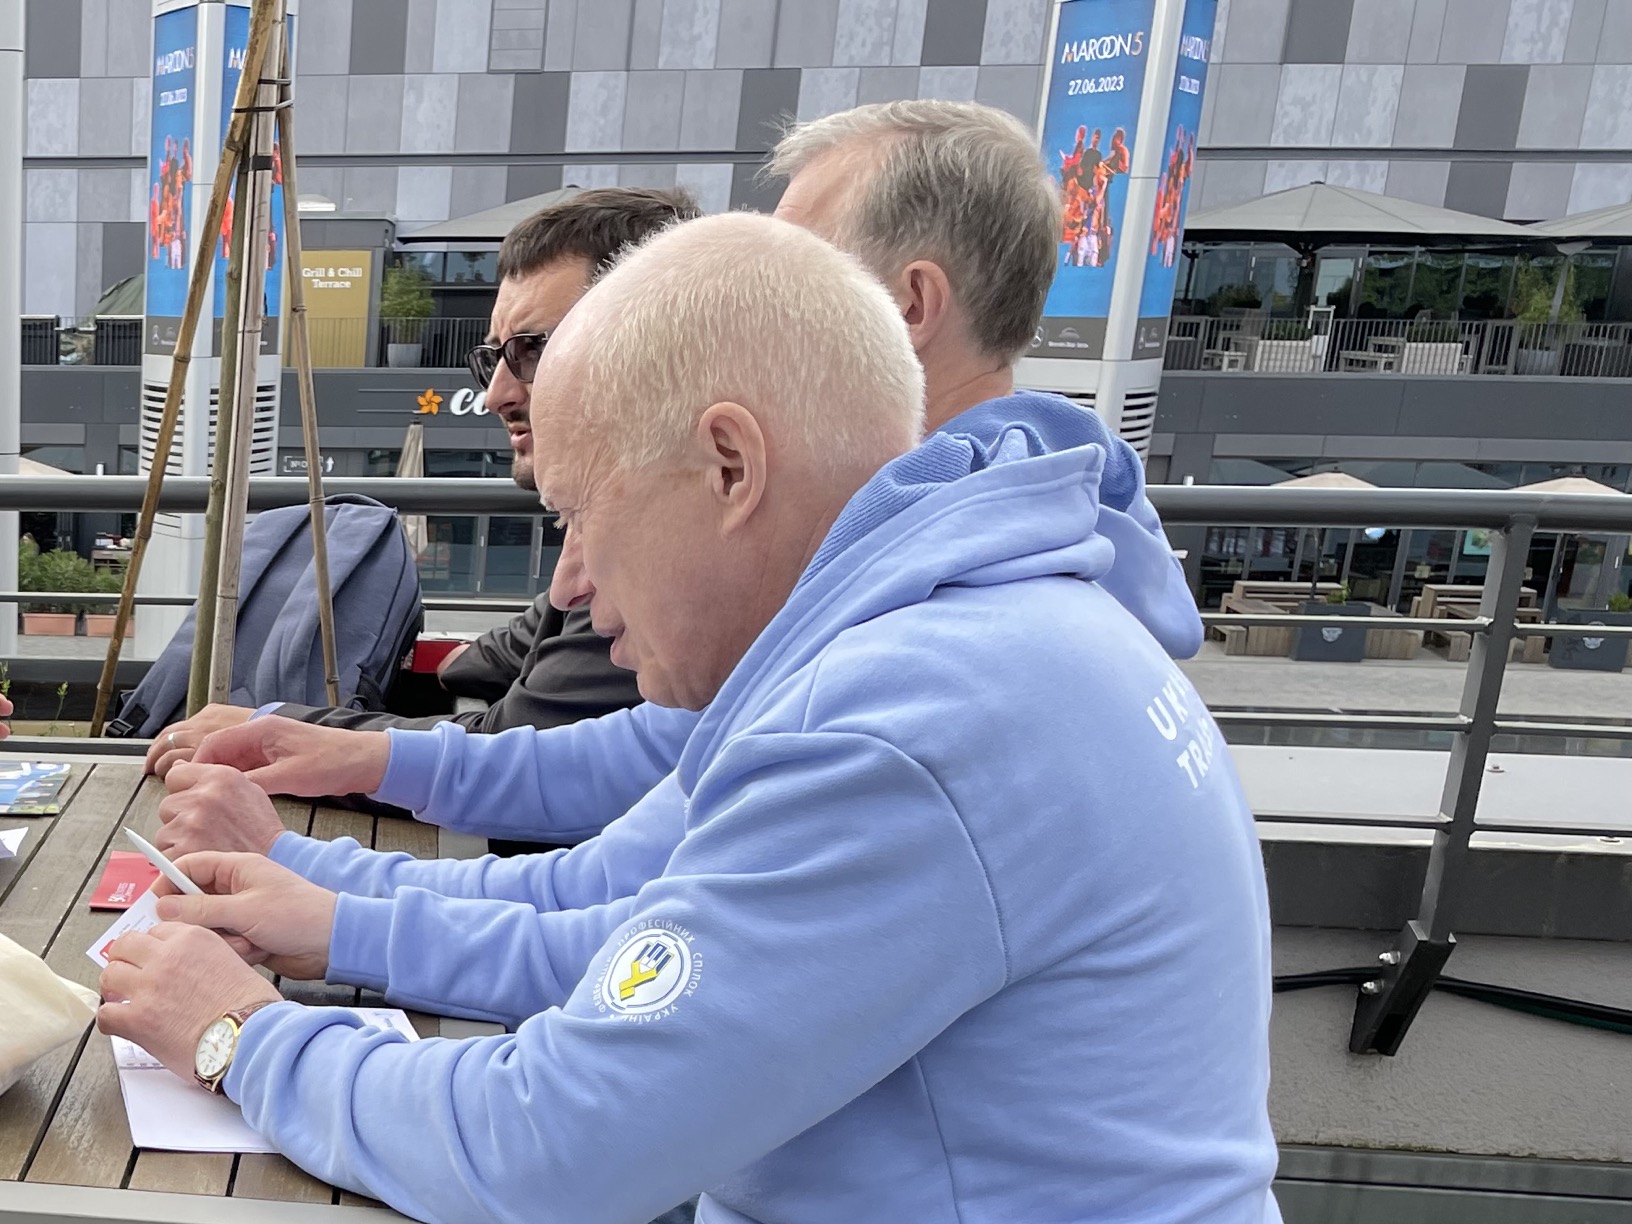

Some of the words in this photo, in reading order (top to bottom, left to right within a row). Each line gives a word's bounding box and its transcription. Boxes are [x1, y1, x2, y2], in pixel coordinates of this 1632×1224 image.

[1061, 33, 1132, 64] MAROON
[1131, 31, 1144, 56] 5
[1068, 74, 1125, 96] 27.06.2023
[303, 267, 326, 278] Grill
[327, 267, 335, 278] &
[338, 267, 363, 278] Chill
[311, 278, 352, 289] Terrace
[682, 952, 704, 998] СПІЛОК
